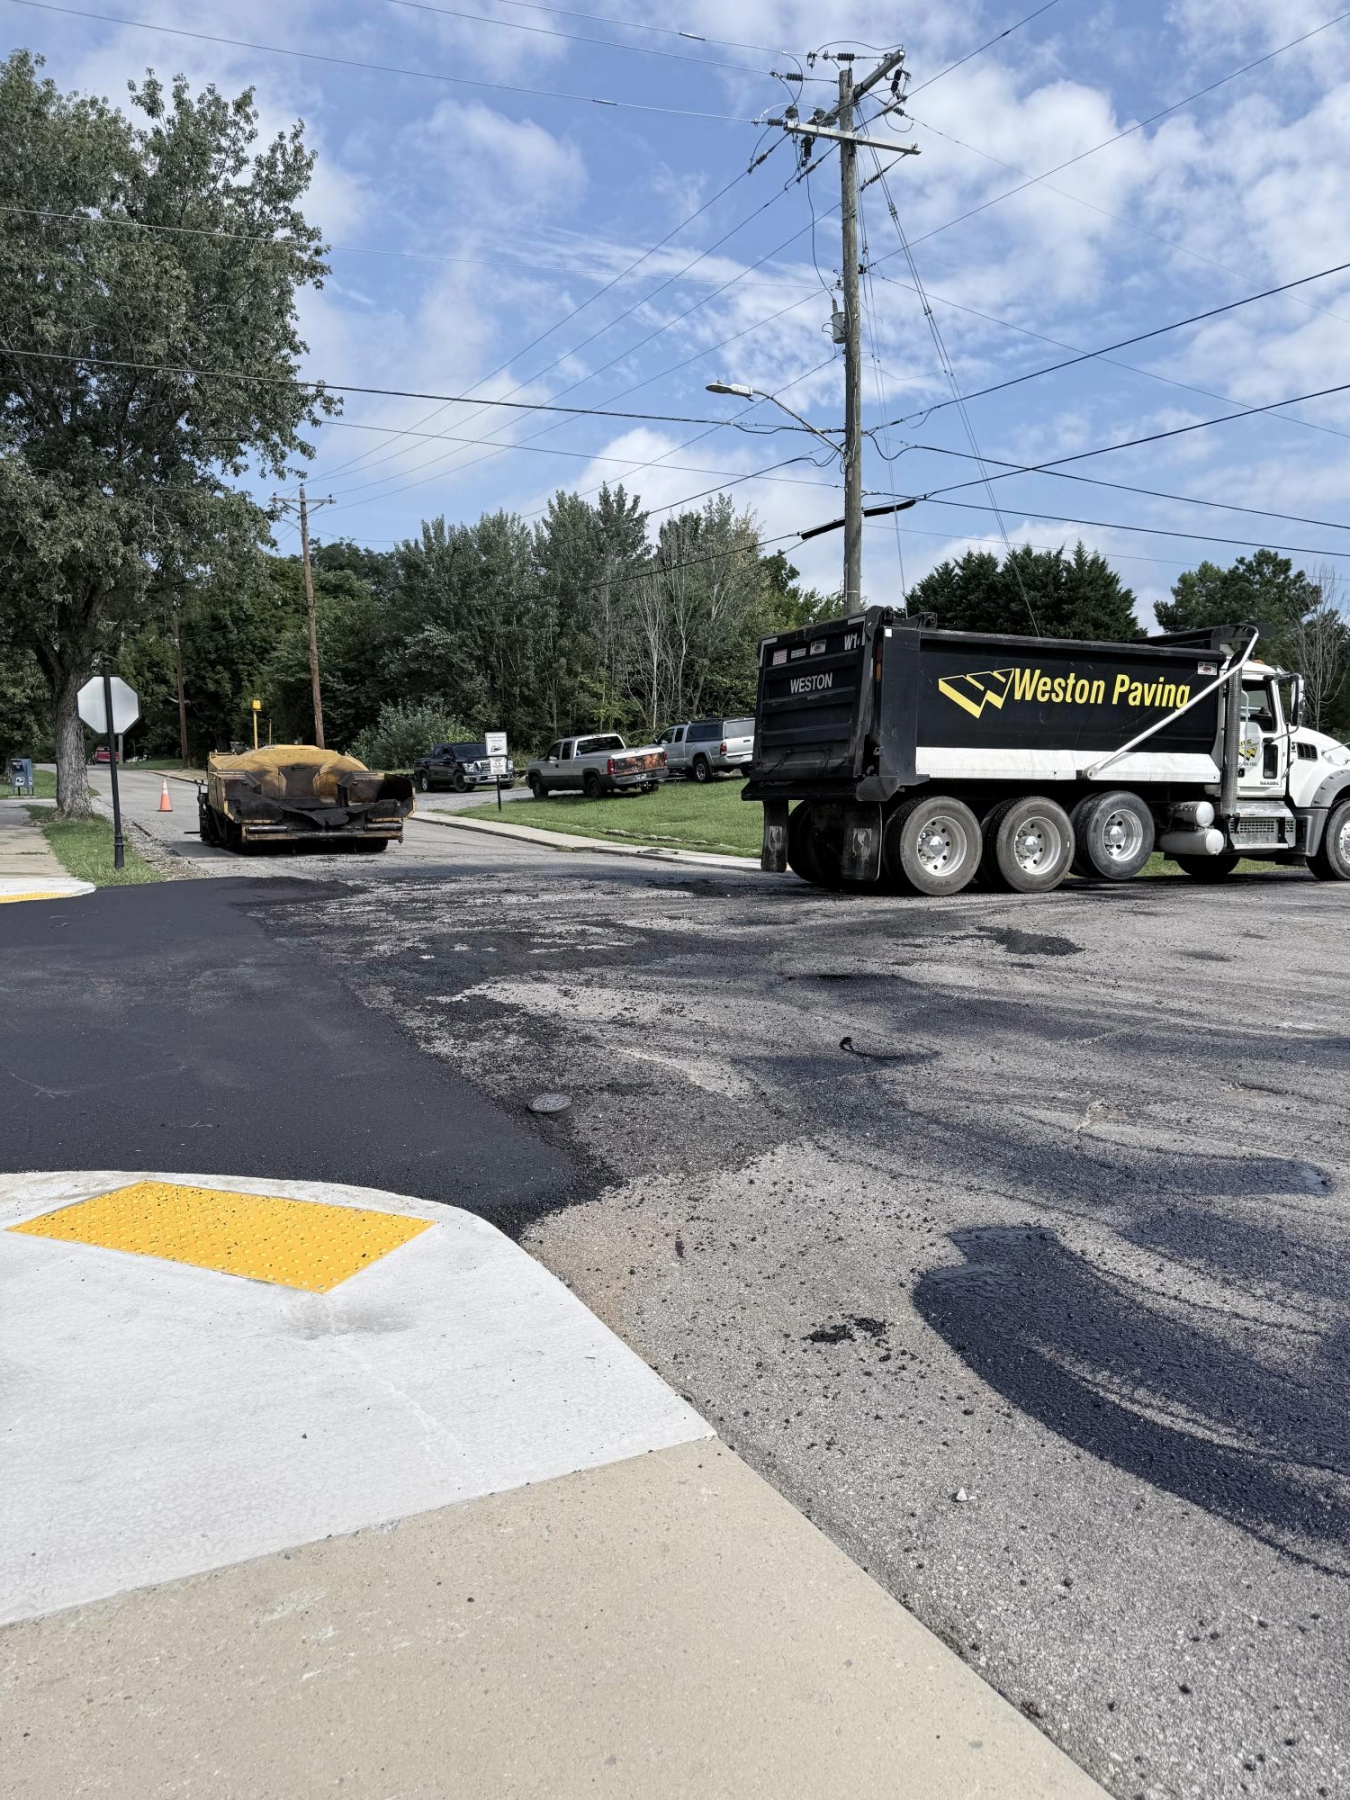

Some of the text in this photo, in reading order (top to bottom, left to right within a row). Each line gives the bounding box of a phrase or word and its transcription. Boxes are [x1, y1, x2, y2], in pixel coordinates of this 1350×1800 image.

[844, 633, 861, 651] W1
[790, 672, 833, 694] WESTON
[1013, 667, 1191, 708] Weston Paving
